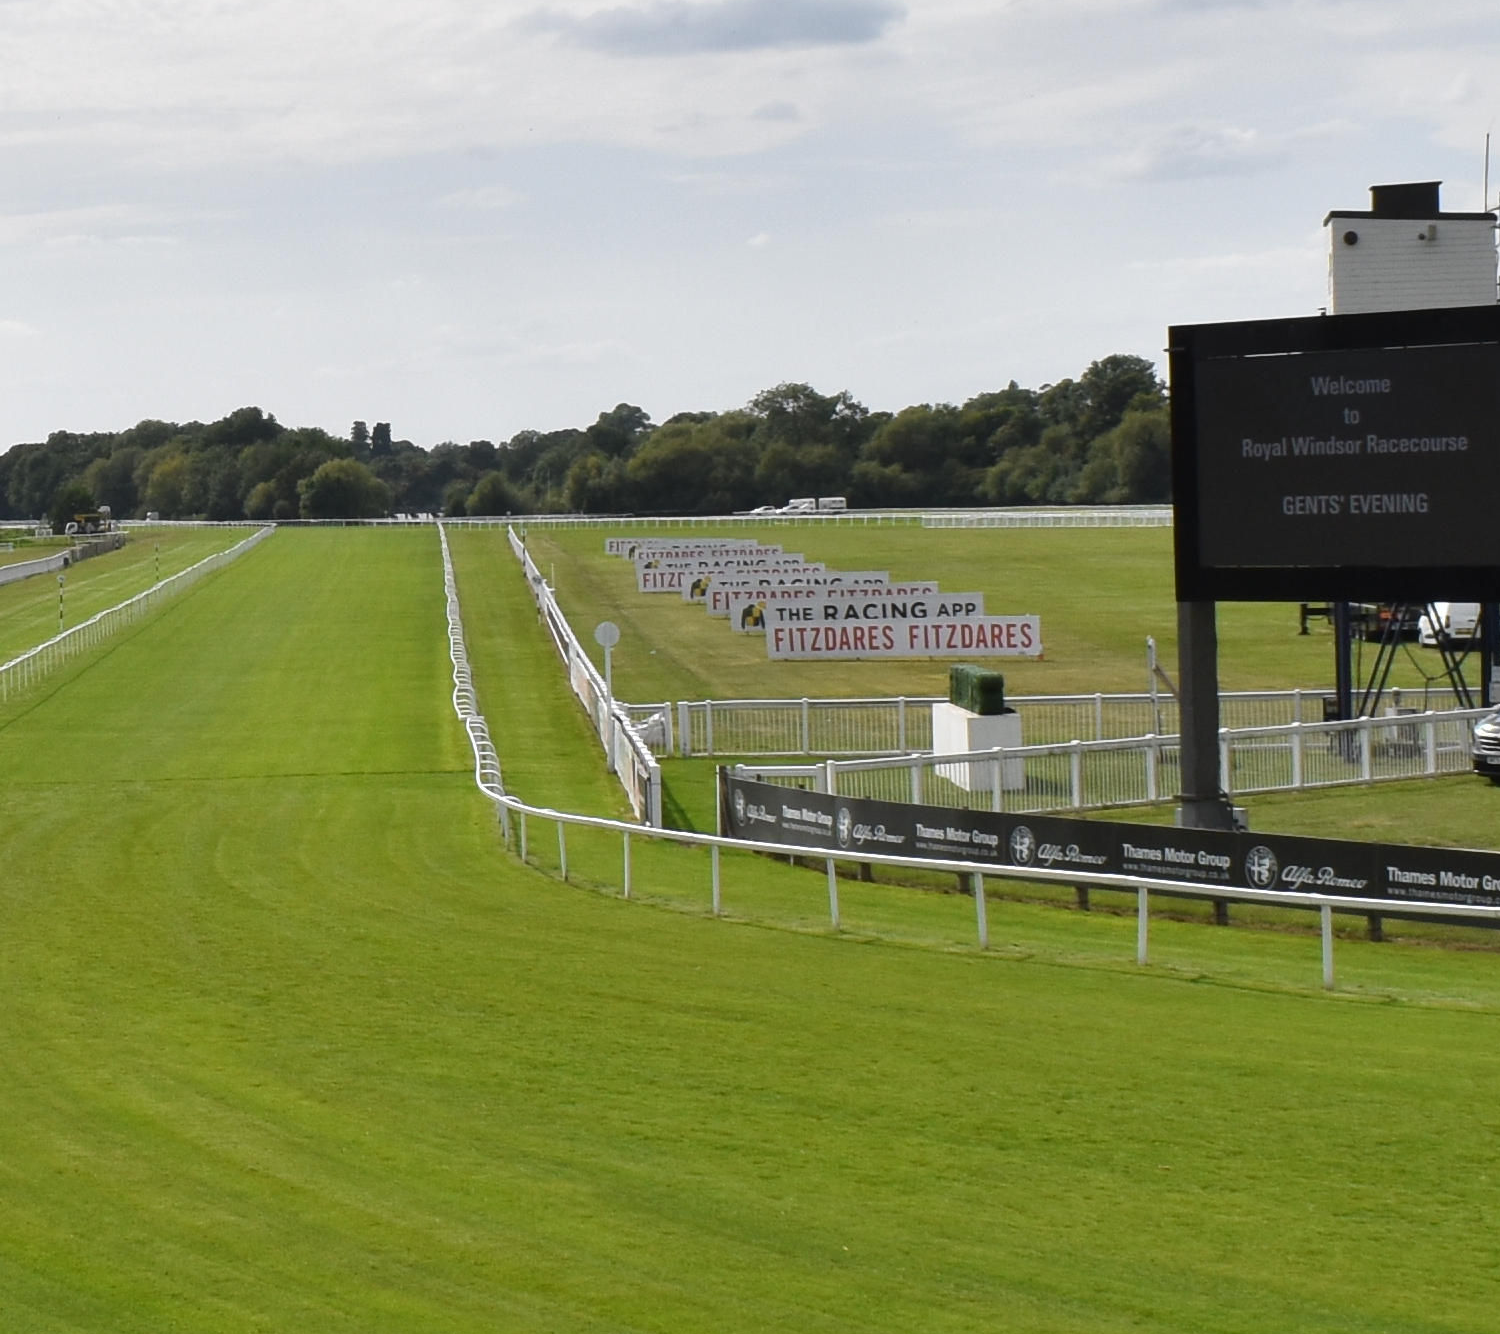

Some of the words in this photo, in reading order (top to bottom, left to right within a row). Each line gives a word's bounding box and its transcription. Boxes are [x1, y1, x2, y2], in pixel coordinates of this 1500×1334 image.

[1311, 376, 1391, 396] Welcome
[1343, 408, 1360, 424] to
[1242, 438, 1287, 460] Royal
[1291, 436, 1362, 456] Windsor
[1367, 434, 1468, 454] Racecourse
[1283, 495, 1345, 515] GENTS'
[1350, 494, 1428, 513] EVENING
[776, 607, 814, 621] THE
[823, 601, 928, 620] RACING
[936, 602, 976, 617] APP
[774, 625, 894, 652] FITZDARES
[908, 623, 1033, 649] FITZDARES
[1037, 843, 1064, 866] Alfa
[1063, 844, 1107, 865] Romeo
[1122, 843, 1162, 861] Thames
[1164, 847, 1196, 864] Motor
[1198, 850, 1231, 870] Group
[1281, 865, 1316, 889] Alfa
[1315, 866, 1368, 889] Romeo
[1386, 866, 1436, 886] Thames
[1440, 871, 1478, 890] Motor
